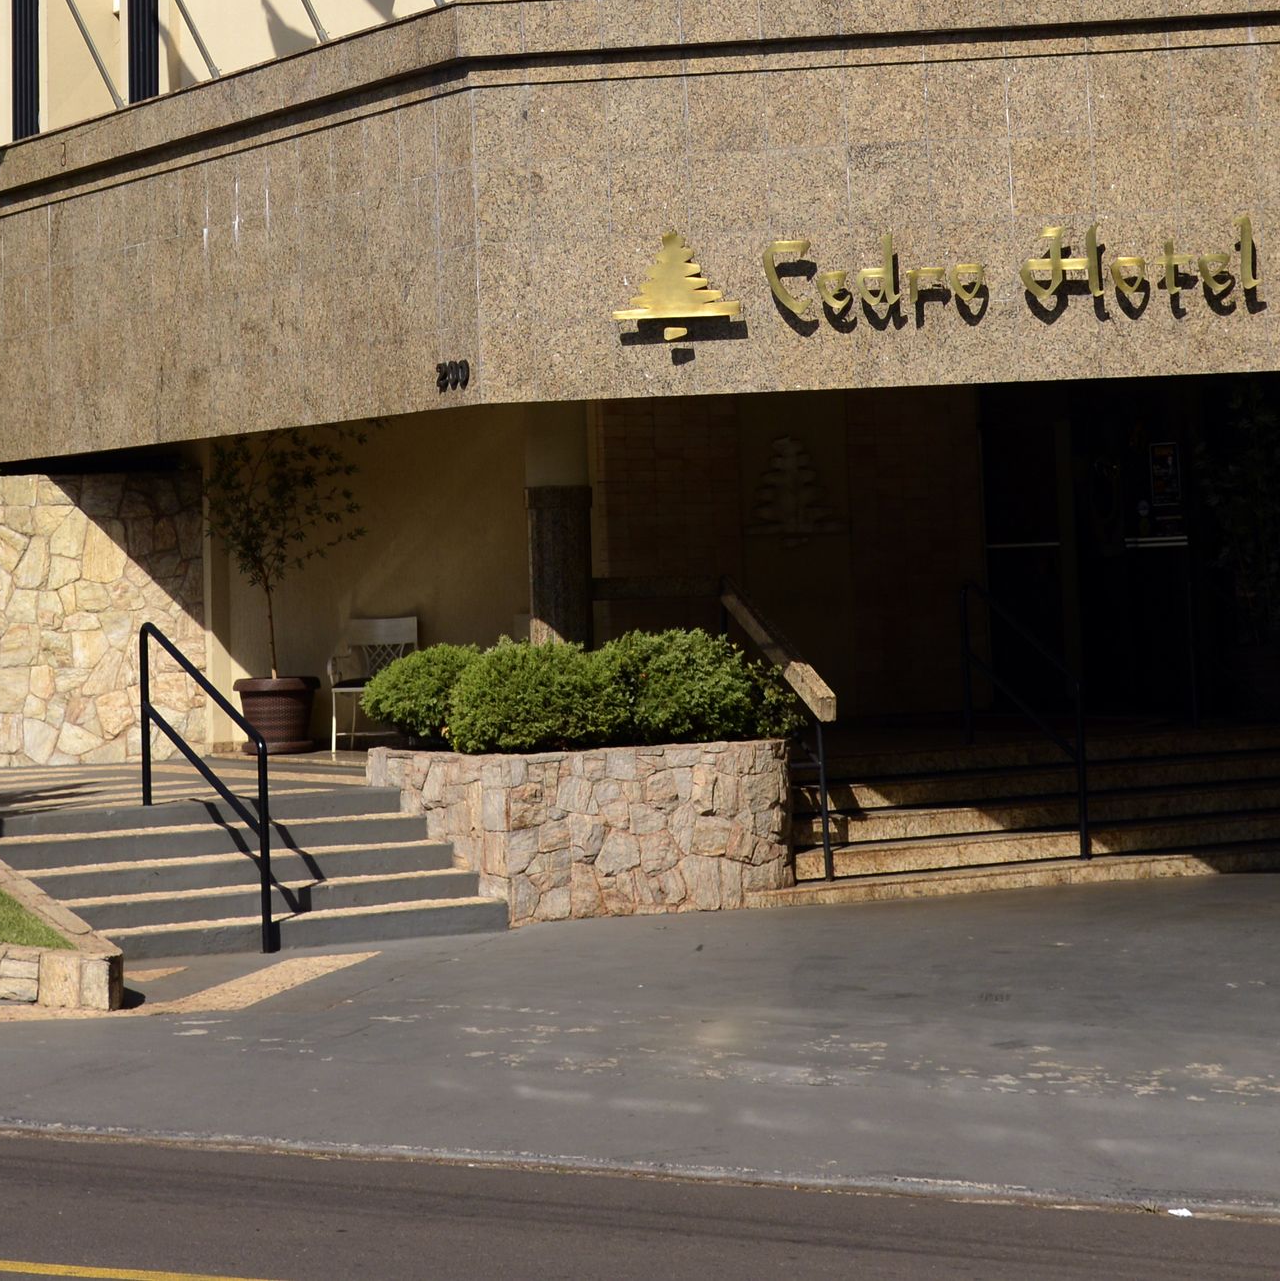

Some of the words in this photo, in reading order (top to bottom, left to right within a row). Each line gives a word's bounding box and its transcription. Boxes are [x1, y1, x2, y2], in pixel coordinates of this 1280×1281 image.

[761, 232, 985, 315] Cedro
[1019, 217, 1261, 300] Hotel
[436, 359, 469, 393] 200
